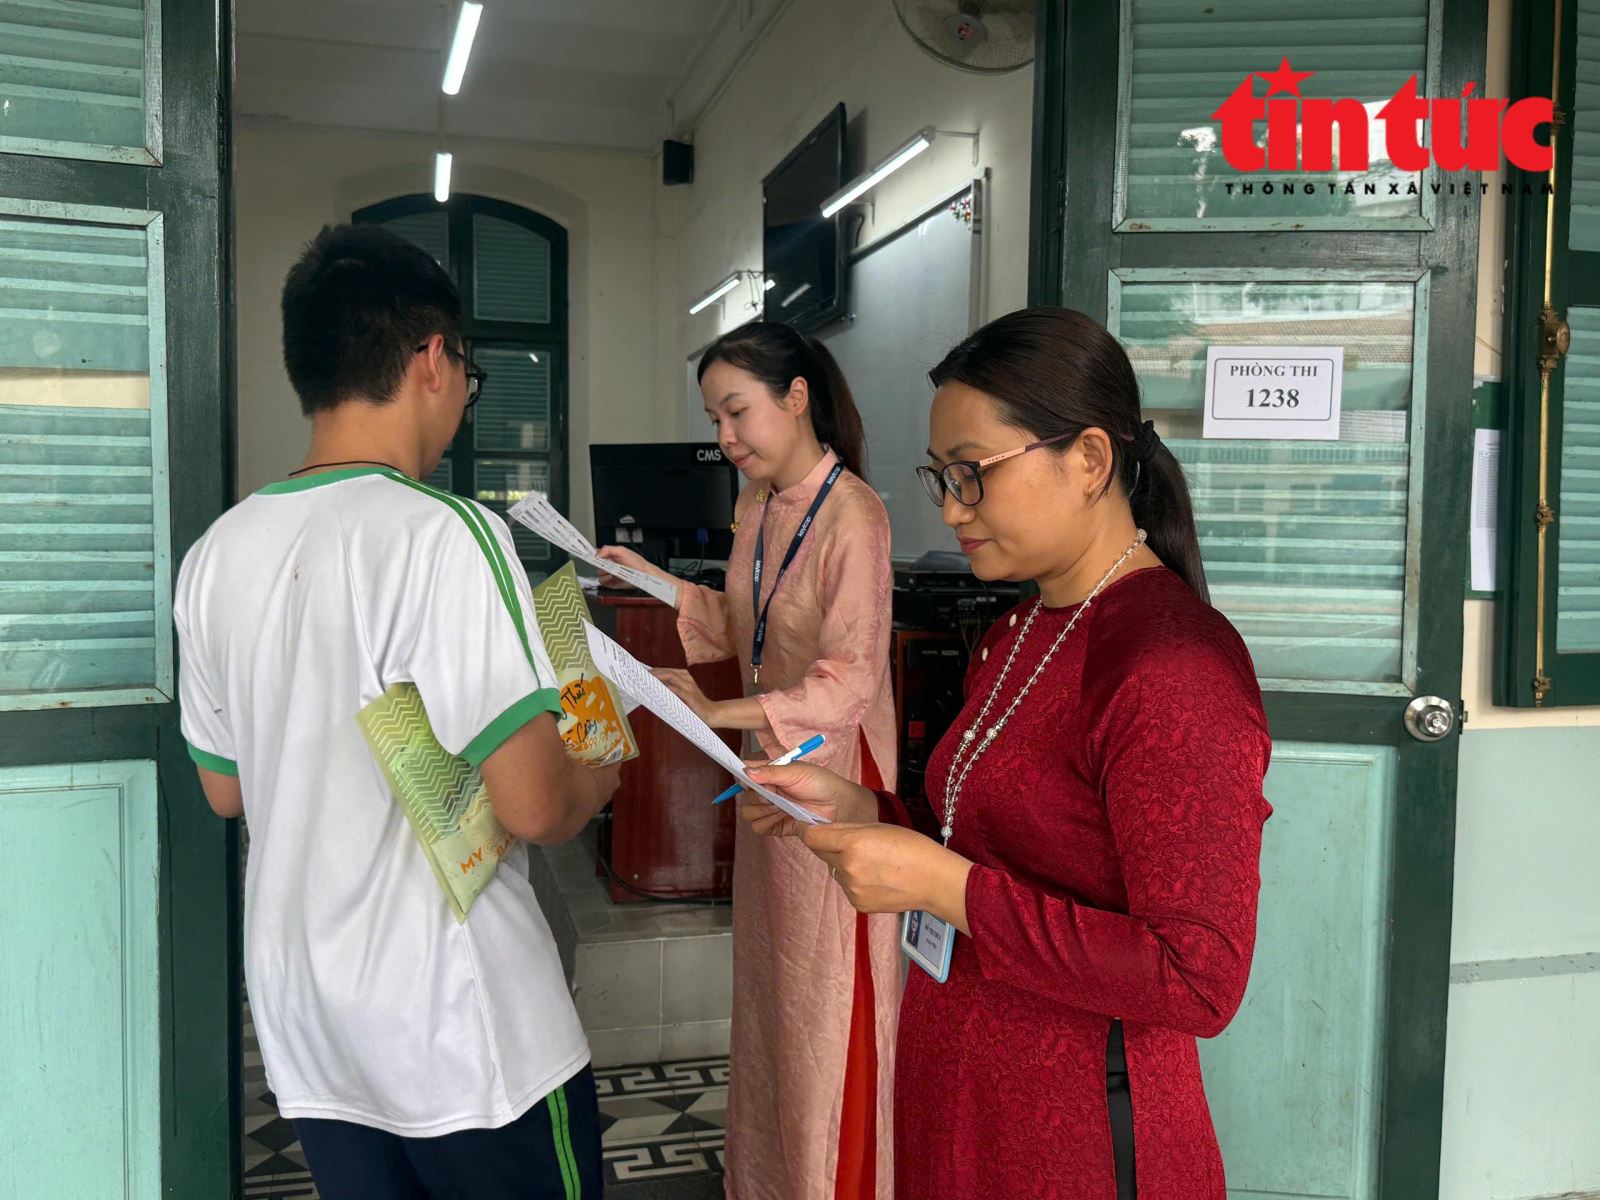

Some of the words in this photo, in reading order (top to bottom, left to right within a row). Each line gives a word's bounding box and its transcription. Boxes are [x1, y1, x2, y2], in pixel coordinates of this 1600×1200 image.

[1230, 362, 1286, 377] PHÒNG
[1290, 365, 1318, 377] THI
[1246, 388, 1300, 408] 1238
[696, 449, 722, 461] CMS
